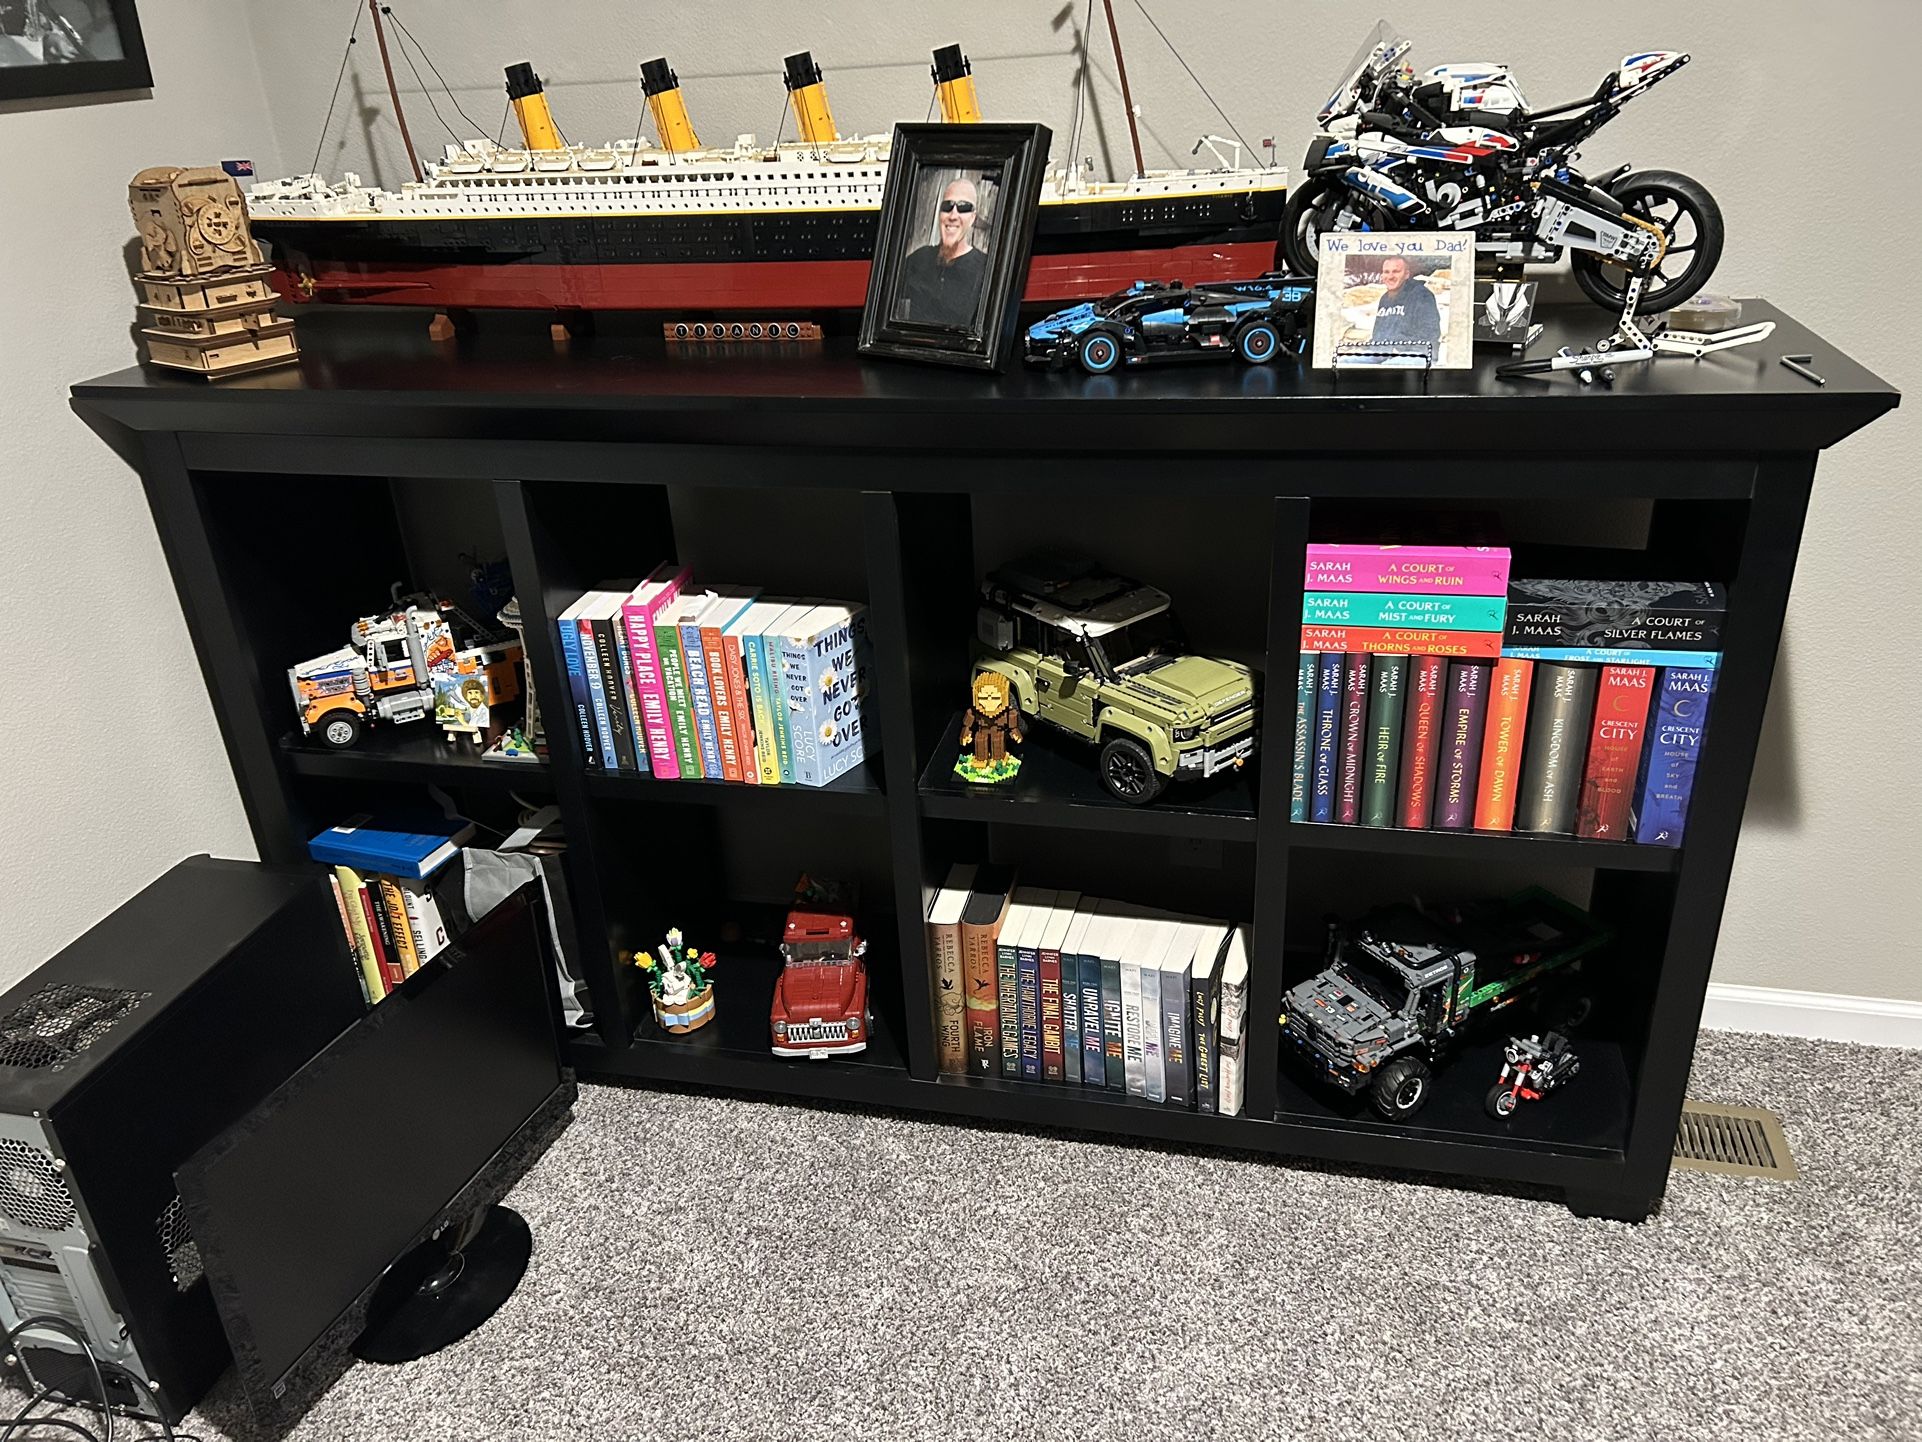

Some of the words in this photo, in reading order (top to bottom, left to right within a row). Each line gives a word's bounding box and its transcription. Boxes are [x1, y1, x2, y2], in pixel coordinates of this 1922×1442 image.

[1327, 239, 1348, 251] We
[1358, 239, 1387, 251] love
[1434, 239, 1467, 251] Dad!
[676, 324, 798, 337] TITANIC
[1310, 561, 1351, 573] SARAH
[1317, 573, 1353, 584] MAAS
[1402, 563, 1445, 574] COURT
[1377, 575, 1418, 586] WINGS
[1434, 576, 1465, 587] RUIN
[1308, 597, 1348, 608] SARAH
[1315, 609, 1351, 620] MAAS
[1398, 601, 1441, 612] COURT
[1378, 612, 1408, 623] MIST
[1425, 614, 1458, 626] FURY
[1517, 613, 1562, 624] SARAH
[1523, 626, 1562, 636] MAAS
[1646, 617, 1692, 628] COURT
[560, 625, 577, 653] UGLY
[628, 615, 650, 651] HAPPY
[814, 617, 866, 657] THINGS
[1305, 628, 1347, 639] SARAH
[1312, 640, 1348, 651] MAAS
[1396, 631, 1438, 642] COURT
[1603, 628, 1647, 640] SILVER
[1651, 629, 1703, 642] FLAMES
[579, 633, 600, 680] NOVEMBER
[728, 643, 738, 661] DAISY
[748, 641, 758, 670] CARRIE
[768, 641, 777, 668] MALIBU
[782, 651, 806, 661] THINGS
[832, 649, 853, 671] WE
[1362, 642, 1412, 653] THORNS
[1427, 645, 1468, 656] ROSES
[567, 654, 581, 677] LOVE
[598, 633, 610, 667] COLLEEN
[605, 669, 617, 700] HOOVER
[635, 651, 658, 685] PLACE
[688, 650, 705, 685] BEACH
[709, 651, 723, 674] BOOK
[731, 662, 742, 688] JONES
[789, 663, 800, 671] WE
[1609, 667, 1640, 676] SARAH
[665, 667, 677, 701] VACATION
[669, 649, 681, 676] PEOPLE
[677, 689, 687, 708] MEET
[752, 672, 762, 693] SOTO
[771, 670, 780, 693] RISING
[785, 673, 807, 682] NEVER
[791, 685, 804, 693] GOT
[823, 667, 866, 704] NEVER
[1347, 669, 1357, 691] MAAS
[1358, 664, 1367, 690] SARAH
[1379, 671, 1389, 693] MAAS
[1390, 665, 1399, 691] SARAH
[1458, 670, 1469, 692] MAAS
[1469, 665, 1479, 691] SARAH
[1553, 675, 1564, 699] MAAS
[1564, 669, 1576, 697] SARAH
[1608, 676, 1647, 688] MAAS
[1668, 681, 1708, 694] MAAS
[1670, 672, 1702, 683] SARAH
[694, 687, 710, 716] READ
[713, 676, 727, 706] LOVERS
[790, 695, 808, 703] OVER
[1214, 690, 1246, 707] DEFENDER
[610, 704, 623, 735] Verity
[643, 693, 665, 727] EMILY
[676, 710, 688, 734] EMILY
[1348, 701, 1360, 740] CROWN
[1418, 703, 1431, 739] QUEEN
[701, 719, 713, 741] EMILY
[718, 710, 732, 737] EMILY
[832, 715, 869, 747] OVER
[1320, 709, 1334, 751] THRONE
[1455, 708, 1470, 747] EMPIRE
[1497, 716, 1513, 754] TOWER
[1599, 728, 1638, 741] CITY
[1601, 719, 1639, 730] CRESCENT
[1661, 723, 1700, 735] CRESCENT
[649, 727, 671, 764] HENRY
[681, 737, 693, 763] HENRY
[792, 725, 806, 764] SCORE
[803, 731, 816, 762] LUCY
[1294, 716, 1308, 770] ASSASSIN'S
[1378, 727, 1391, 751] HEIR
[1548, 718, 1564, 768] KINGDOM
[1660, 732, 1699, 746] CITY
[705, 742, 716, 763] HENRY
[723, 739, 737, 765] HENRY
[1664, 751, 1689, 759] HOUSE
[823, 756, 849, 780] LUCY
[1317, 765, 1330, 795] GLASS
[1343, 754, 1357, 803] MIDNIGHT
[1374, 764, 1388, 784] FIRE
[1292, 771, 1304, 802] BLADE
[1410, 756, 1426, 808] SHADOWS
[1448, 762, 1465, 804] STORMS
[1491, 770, 1506, 802] DAWN
[1543, 781, 1556, 802] ASH
[1597, 787, 1621, 795] BLOOD
[1656, 793, 1683, 801] BREATH
[383, 880, 396, 898] THE
[391, 921, 408, 950] EFFECT
[377, 913, 390, 946] AWAKENING
[413, 930, 427, 961] SELLING
[935, 936, 944, 970] YARROS
[946, 933, 956, 974] REBECCA
[969, 936, 977, 970] YARROS
[980, 933, 990, 974] REBECCA
[999, 963, 1016, 980] THE
[1020, 968, 1036, 984] THE
[1042, 978, 1059, 996] THE
[1000, 980, 1018, 1029] INHERITANCE
[1021, 984, 1037, 1029] HAWTHORNE
[1042, 996, 1060, 1021] FINAL
[1063, 992, 1077, 1031] SHATTER
[1082, 987, 1100, 1034] UNRAVEL
[1103, 1000, 1122, 1038] IGNITE
[1125, 1004, 1141, 1046] RESTORE
[1167, 1012, 1182, 1049] IMAGINE
[942, 1024, 951, 1048] WING
[949, 1020, 961, 1053] FOURTH
[974, 1020, 986, 1053] FLAME
[984, 1026, 994, 1048] IRON
[1002, 1030, 1019, 1059] GAMES
[1022, 1030, 1039, 1059] LEGACY
[1043, 1023, 1061, 1054] GAMBIT
[1085, 1035, 1101, 1053] ME
[1127, 1045, 1143, 1063] ME
[1198, 1046, 1209, 1073] GUEST
[1199, 1074, 1209, 1089] LIST
